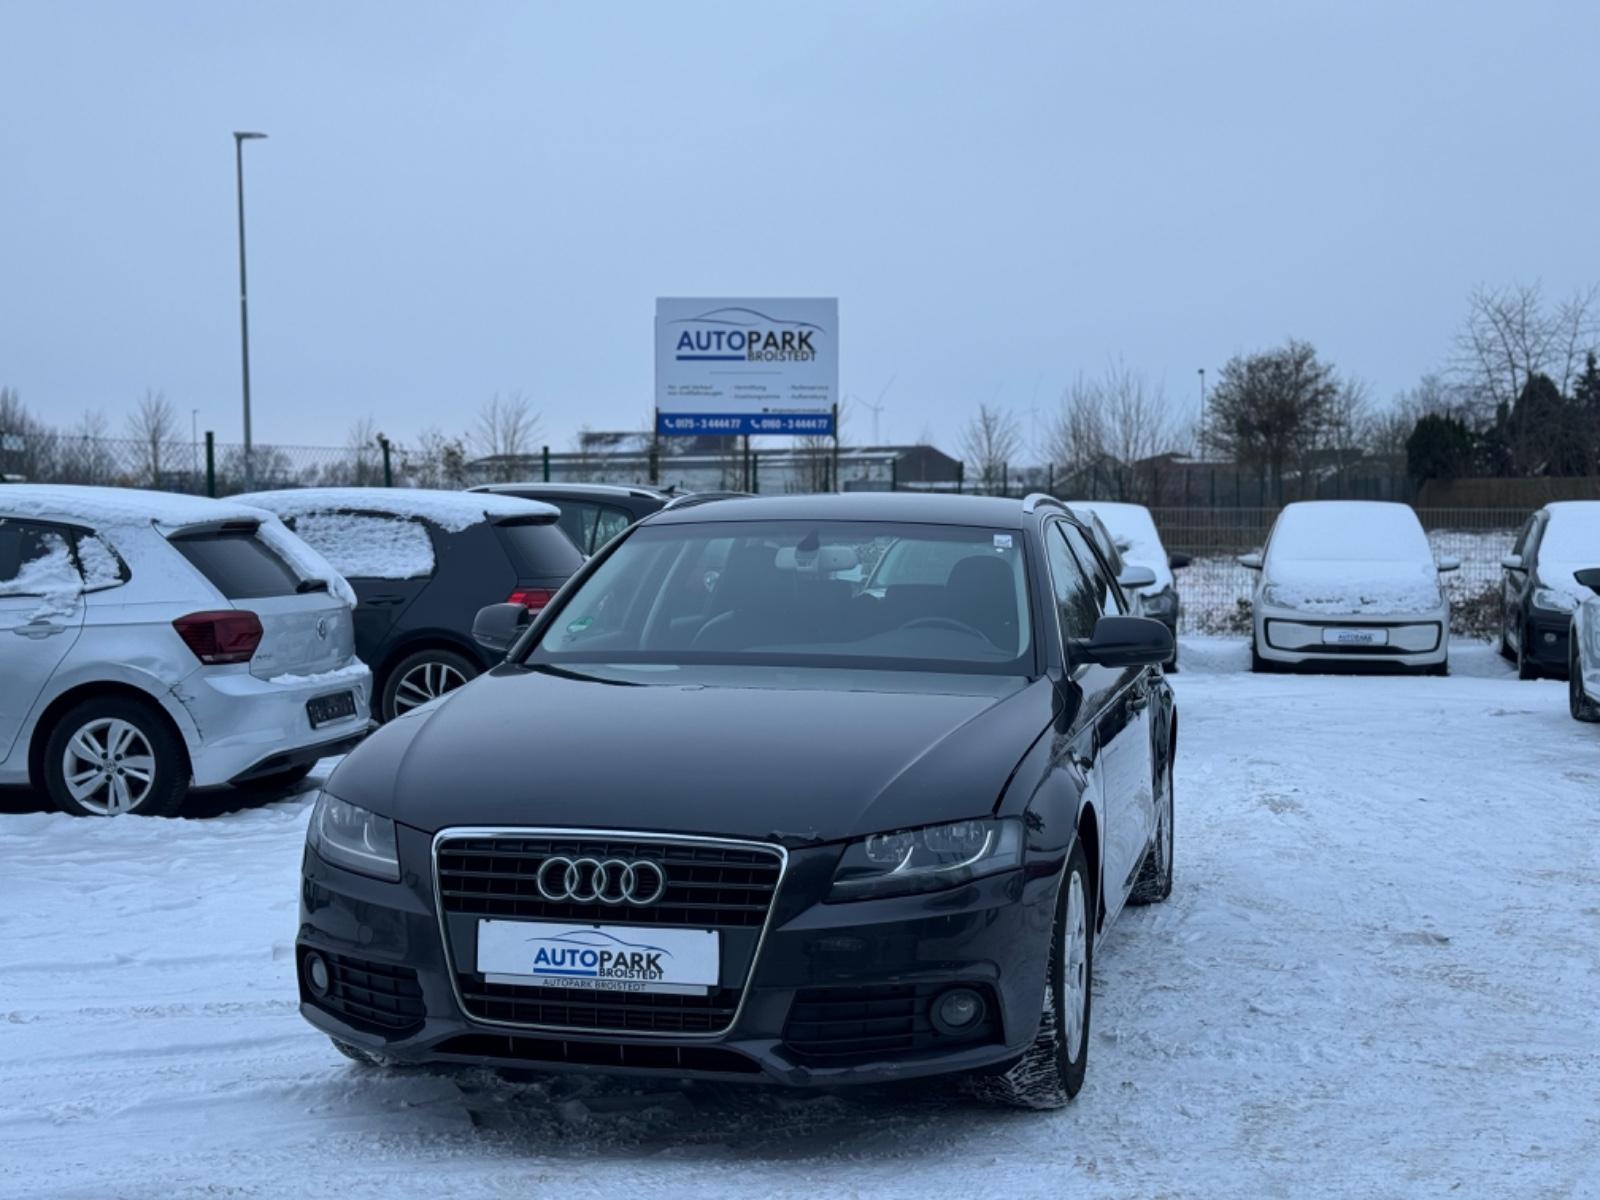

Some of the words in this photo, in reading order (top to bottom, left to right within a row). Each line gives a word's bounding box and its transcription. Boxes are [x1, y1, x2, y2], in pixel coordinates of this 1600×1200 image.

[676, 330, 816, 351] AUTOPARK
[747, 350, 816, 362] BROISTEDT
[534, 947, 663, 973] AUTOPARK
[598, 967, 663, 980] BROISTEDT
[543, 979, 593, 988] AUTOPARK
[595, 980, 646, 991] BROISTEDT
